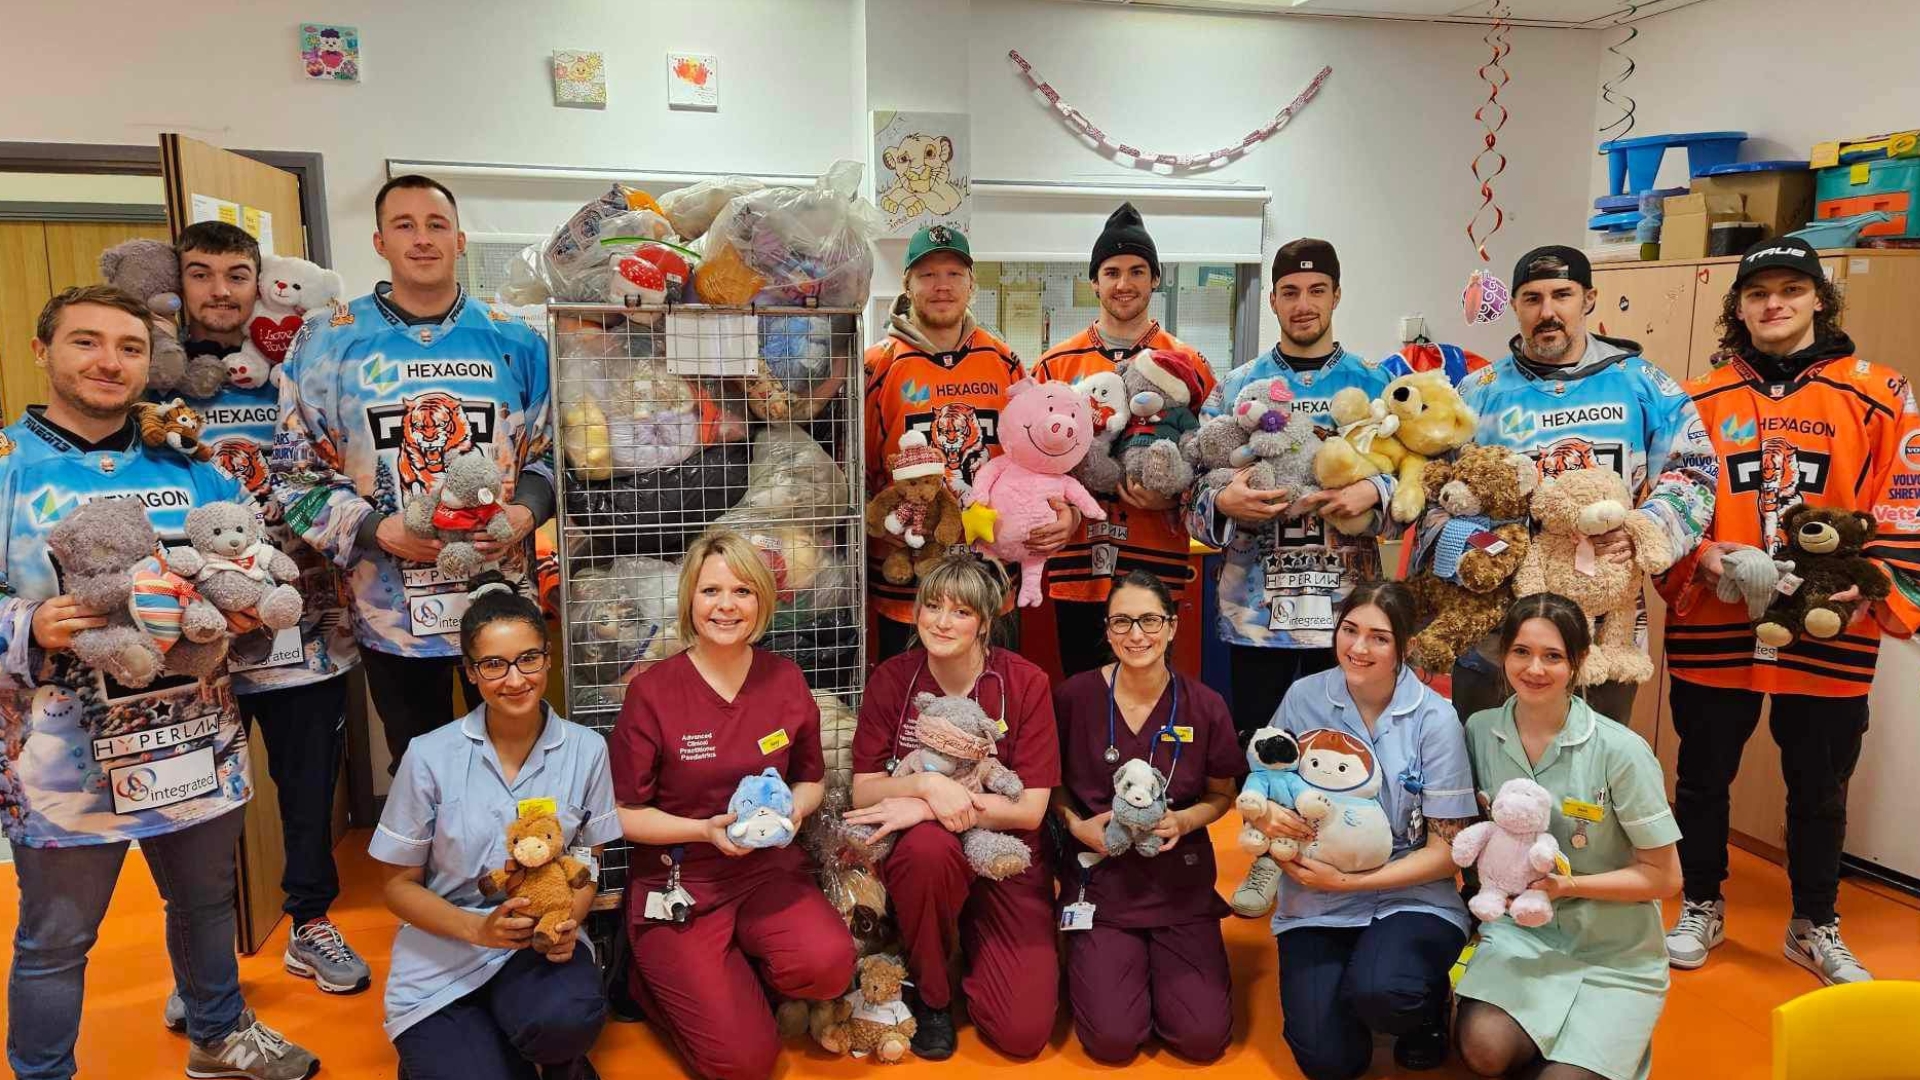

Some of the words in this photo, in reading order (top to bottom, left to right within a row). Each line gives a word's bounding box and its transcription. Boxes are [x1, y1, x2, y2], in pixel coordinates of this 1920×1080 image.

[1746, 247, 1806, 262] TRUE
[407, 363, 494, 378] HEXAGON
[936, 382, 999, 397] HEXAGON
[1291, 401, 1333, 413] HEXA
[205, 408, 279, 425] HEXAGO
[1542, 407, 1623, 428] HEXAGON
[1759, 417, 1836, 438] HEXAGON
[95, 717, 219, 757] HYPERLAW
[150, 772, 215, 801] integrated
